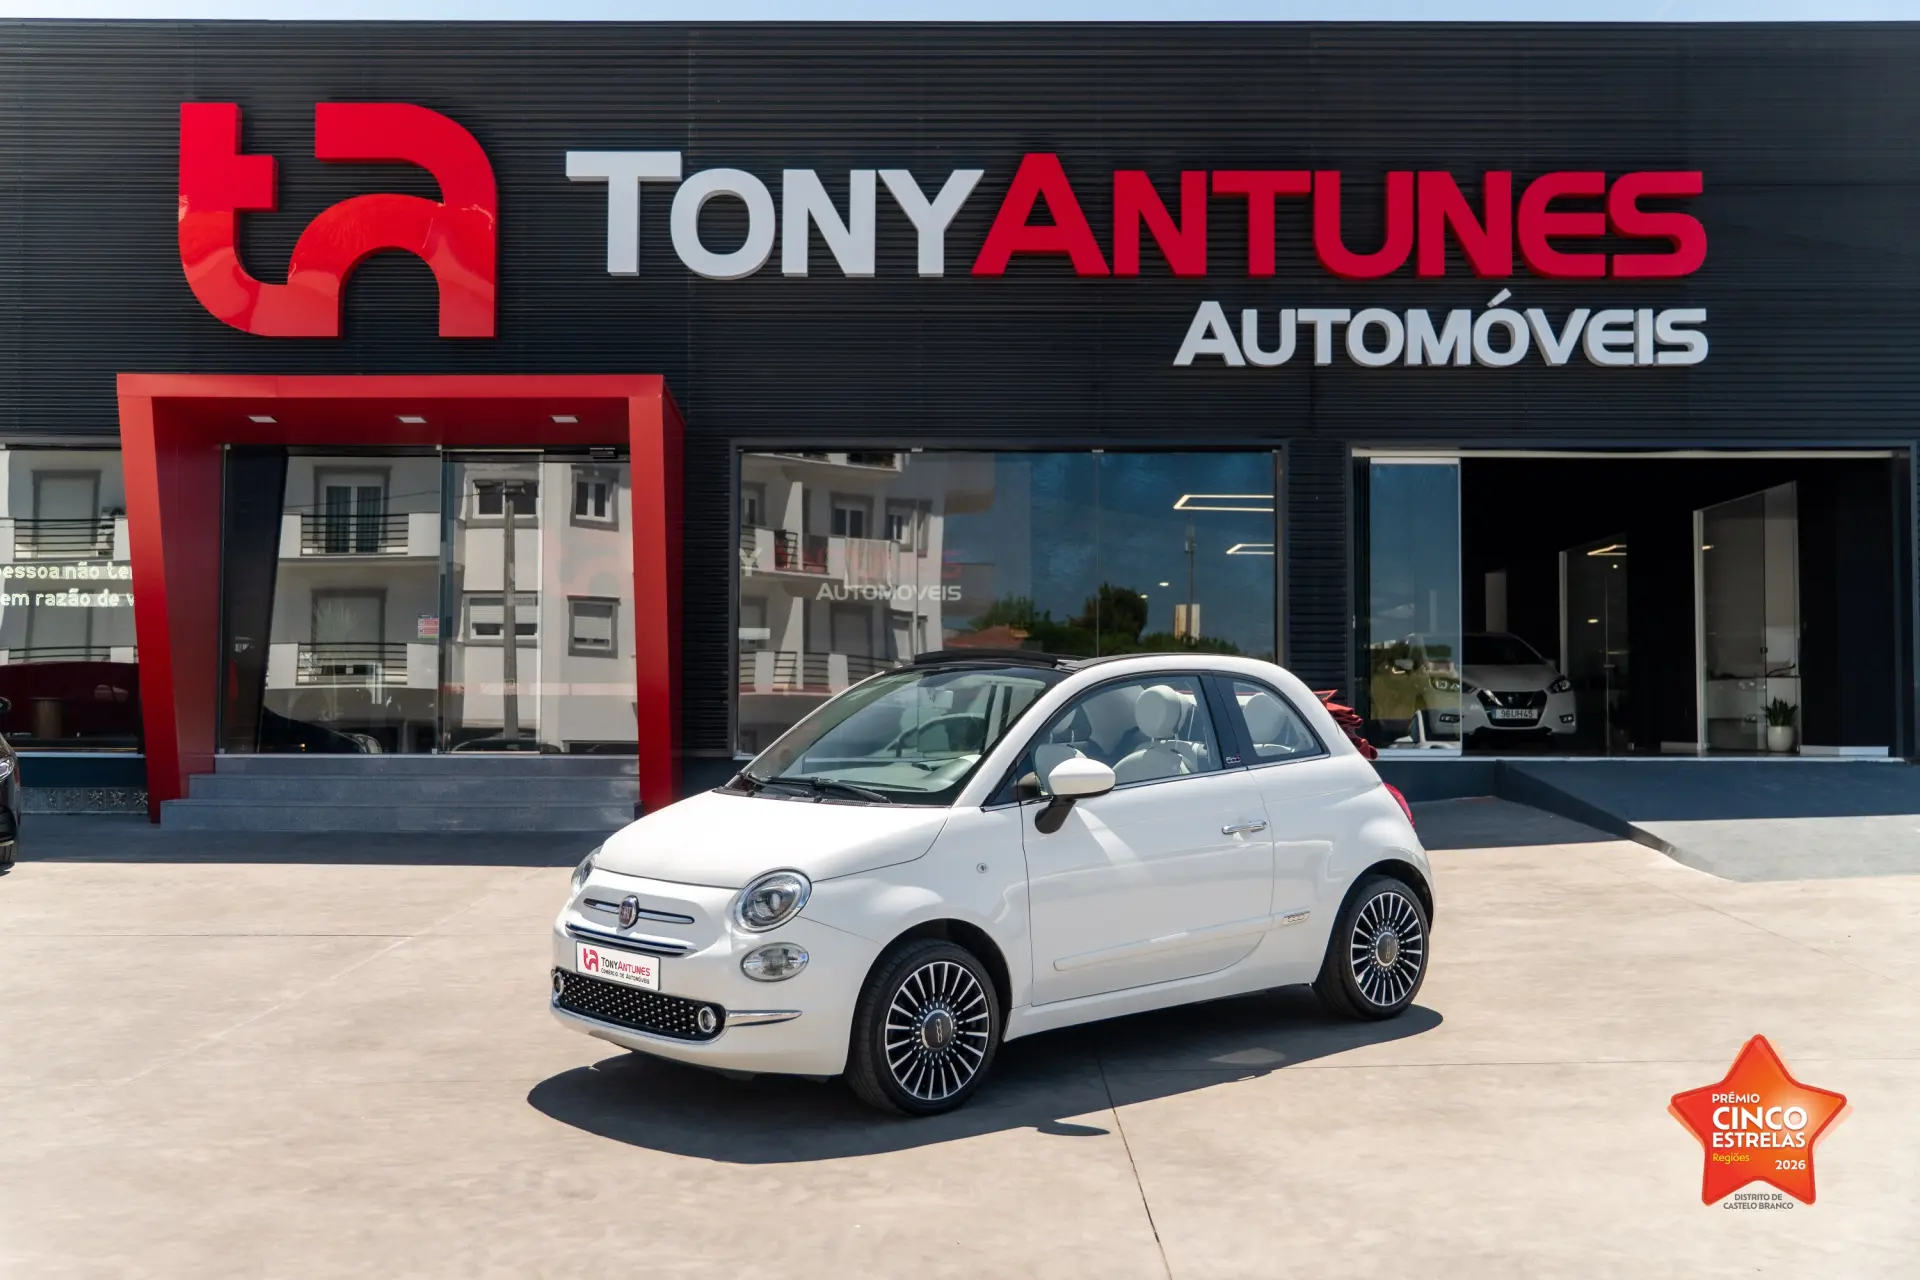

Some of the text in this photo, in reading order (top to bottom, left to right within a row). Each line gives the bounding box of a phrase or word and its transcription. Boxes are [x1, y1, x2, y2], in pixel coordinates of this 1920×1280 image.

[1173, 288, 1709, 367] AUTOMÓVEIS
[0, 565, 60, 579] essoa
[65, 561, 100, 580] não
[35, 588, 91, 606] razão
[97, 588, 120, 606] de
